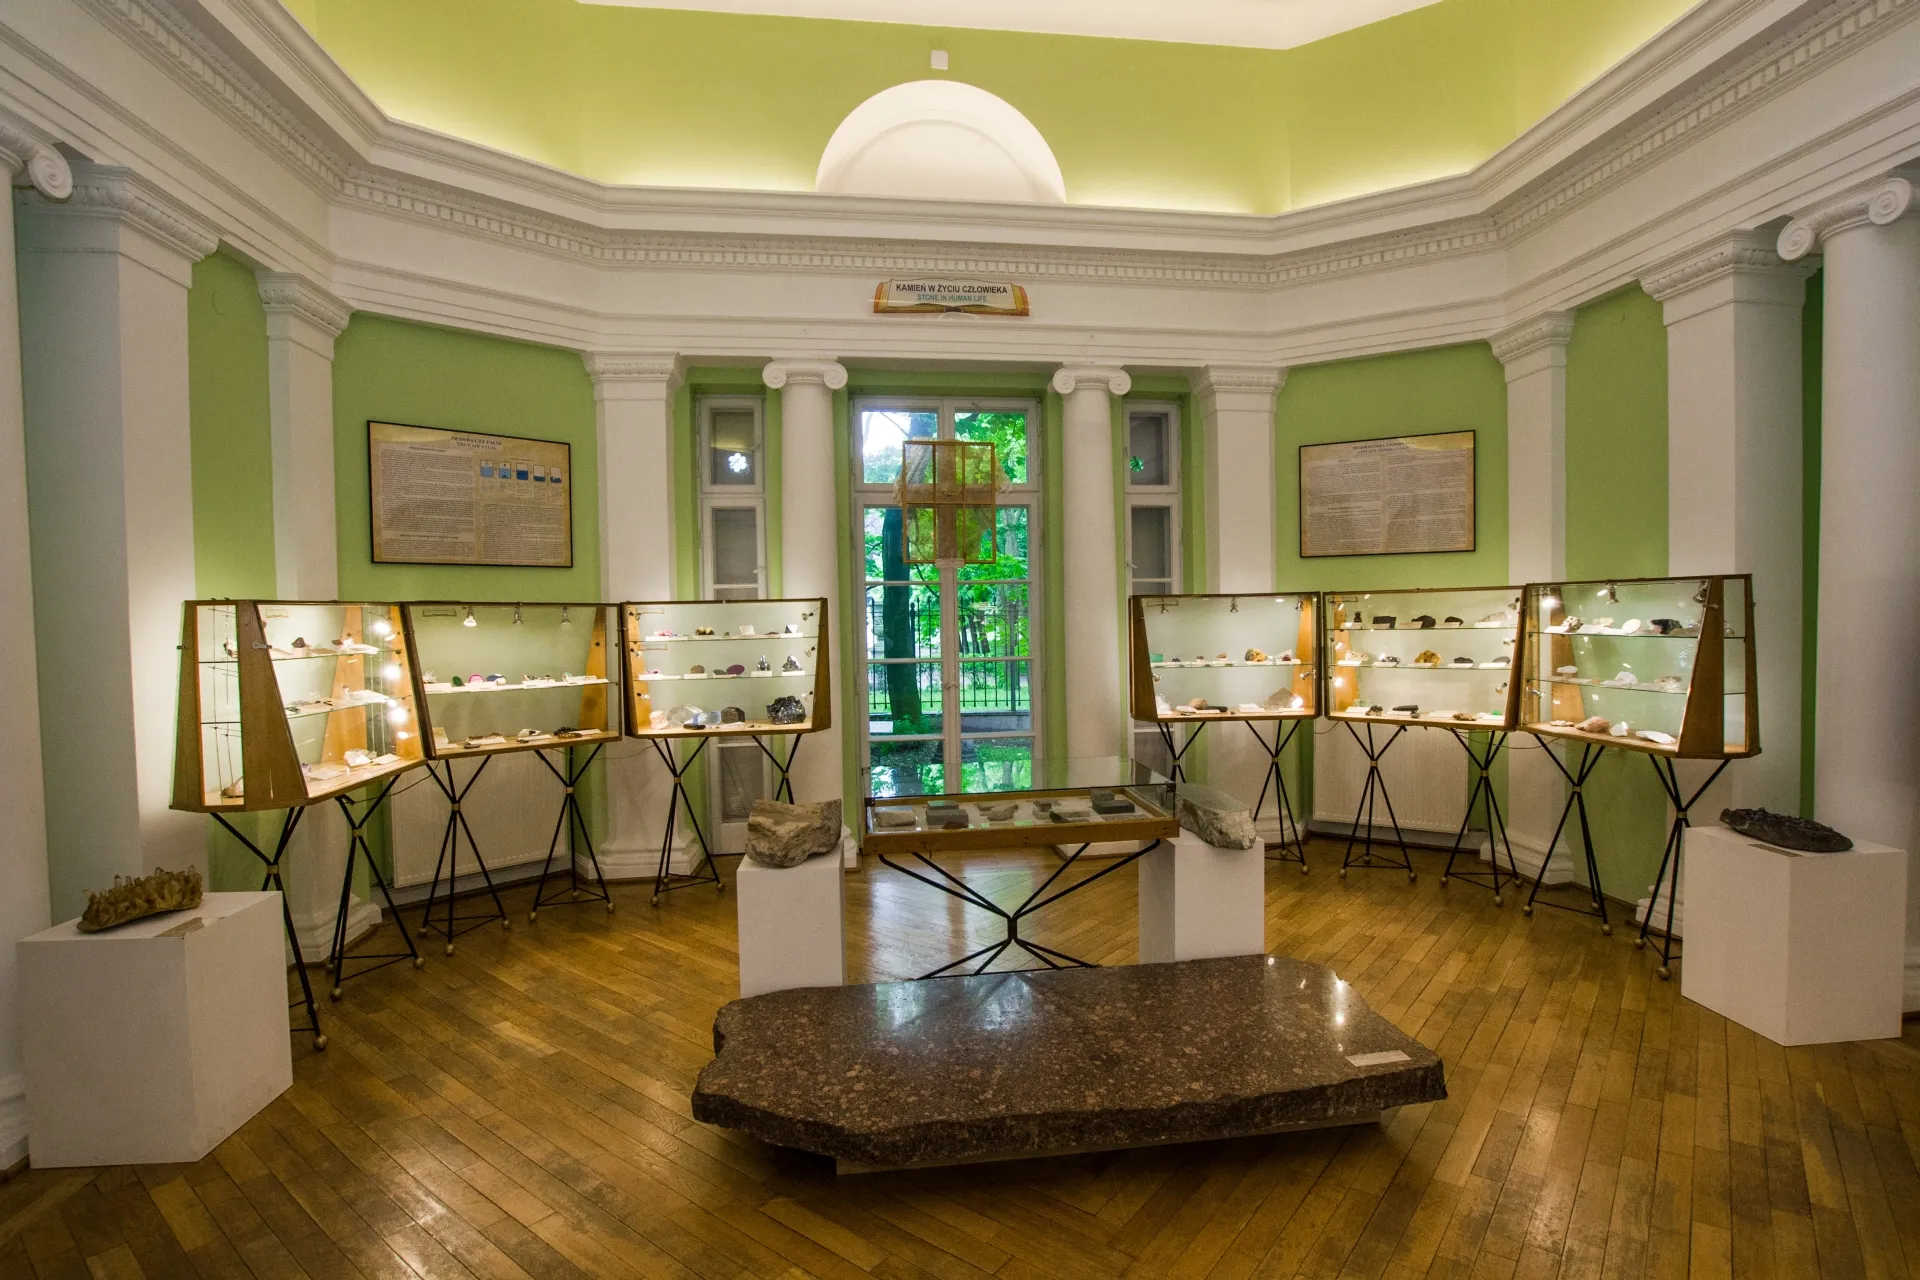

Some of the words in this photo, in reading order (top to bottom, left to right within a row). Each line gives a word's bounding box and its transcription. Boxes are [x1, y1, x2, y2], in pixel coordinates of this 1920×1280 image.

[896, 283, 926, 292] KAMIEŃ
[928, 284, 936, 292] W
[937, 283, 960, 293] ŻYCIU
[963, 285, 1008, 294] CZŁOWIEKA
